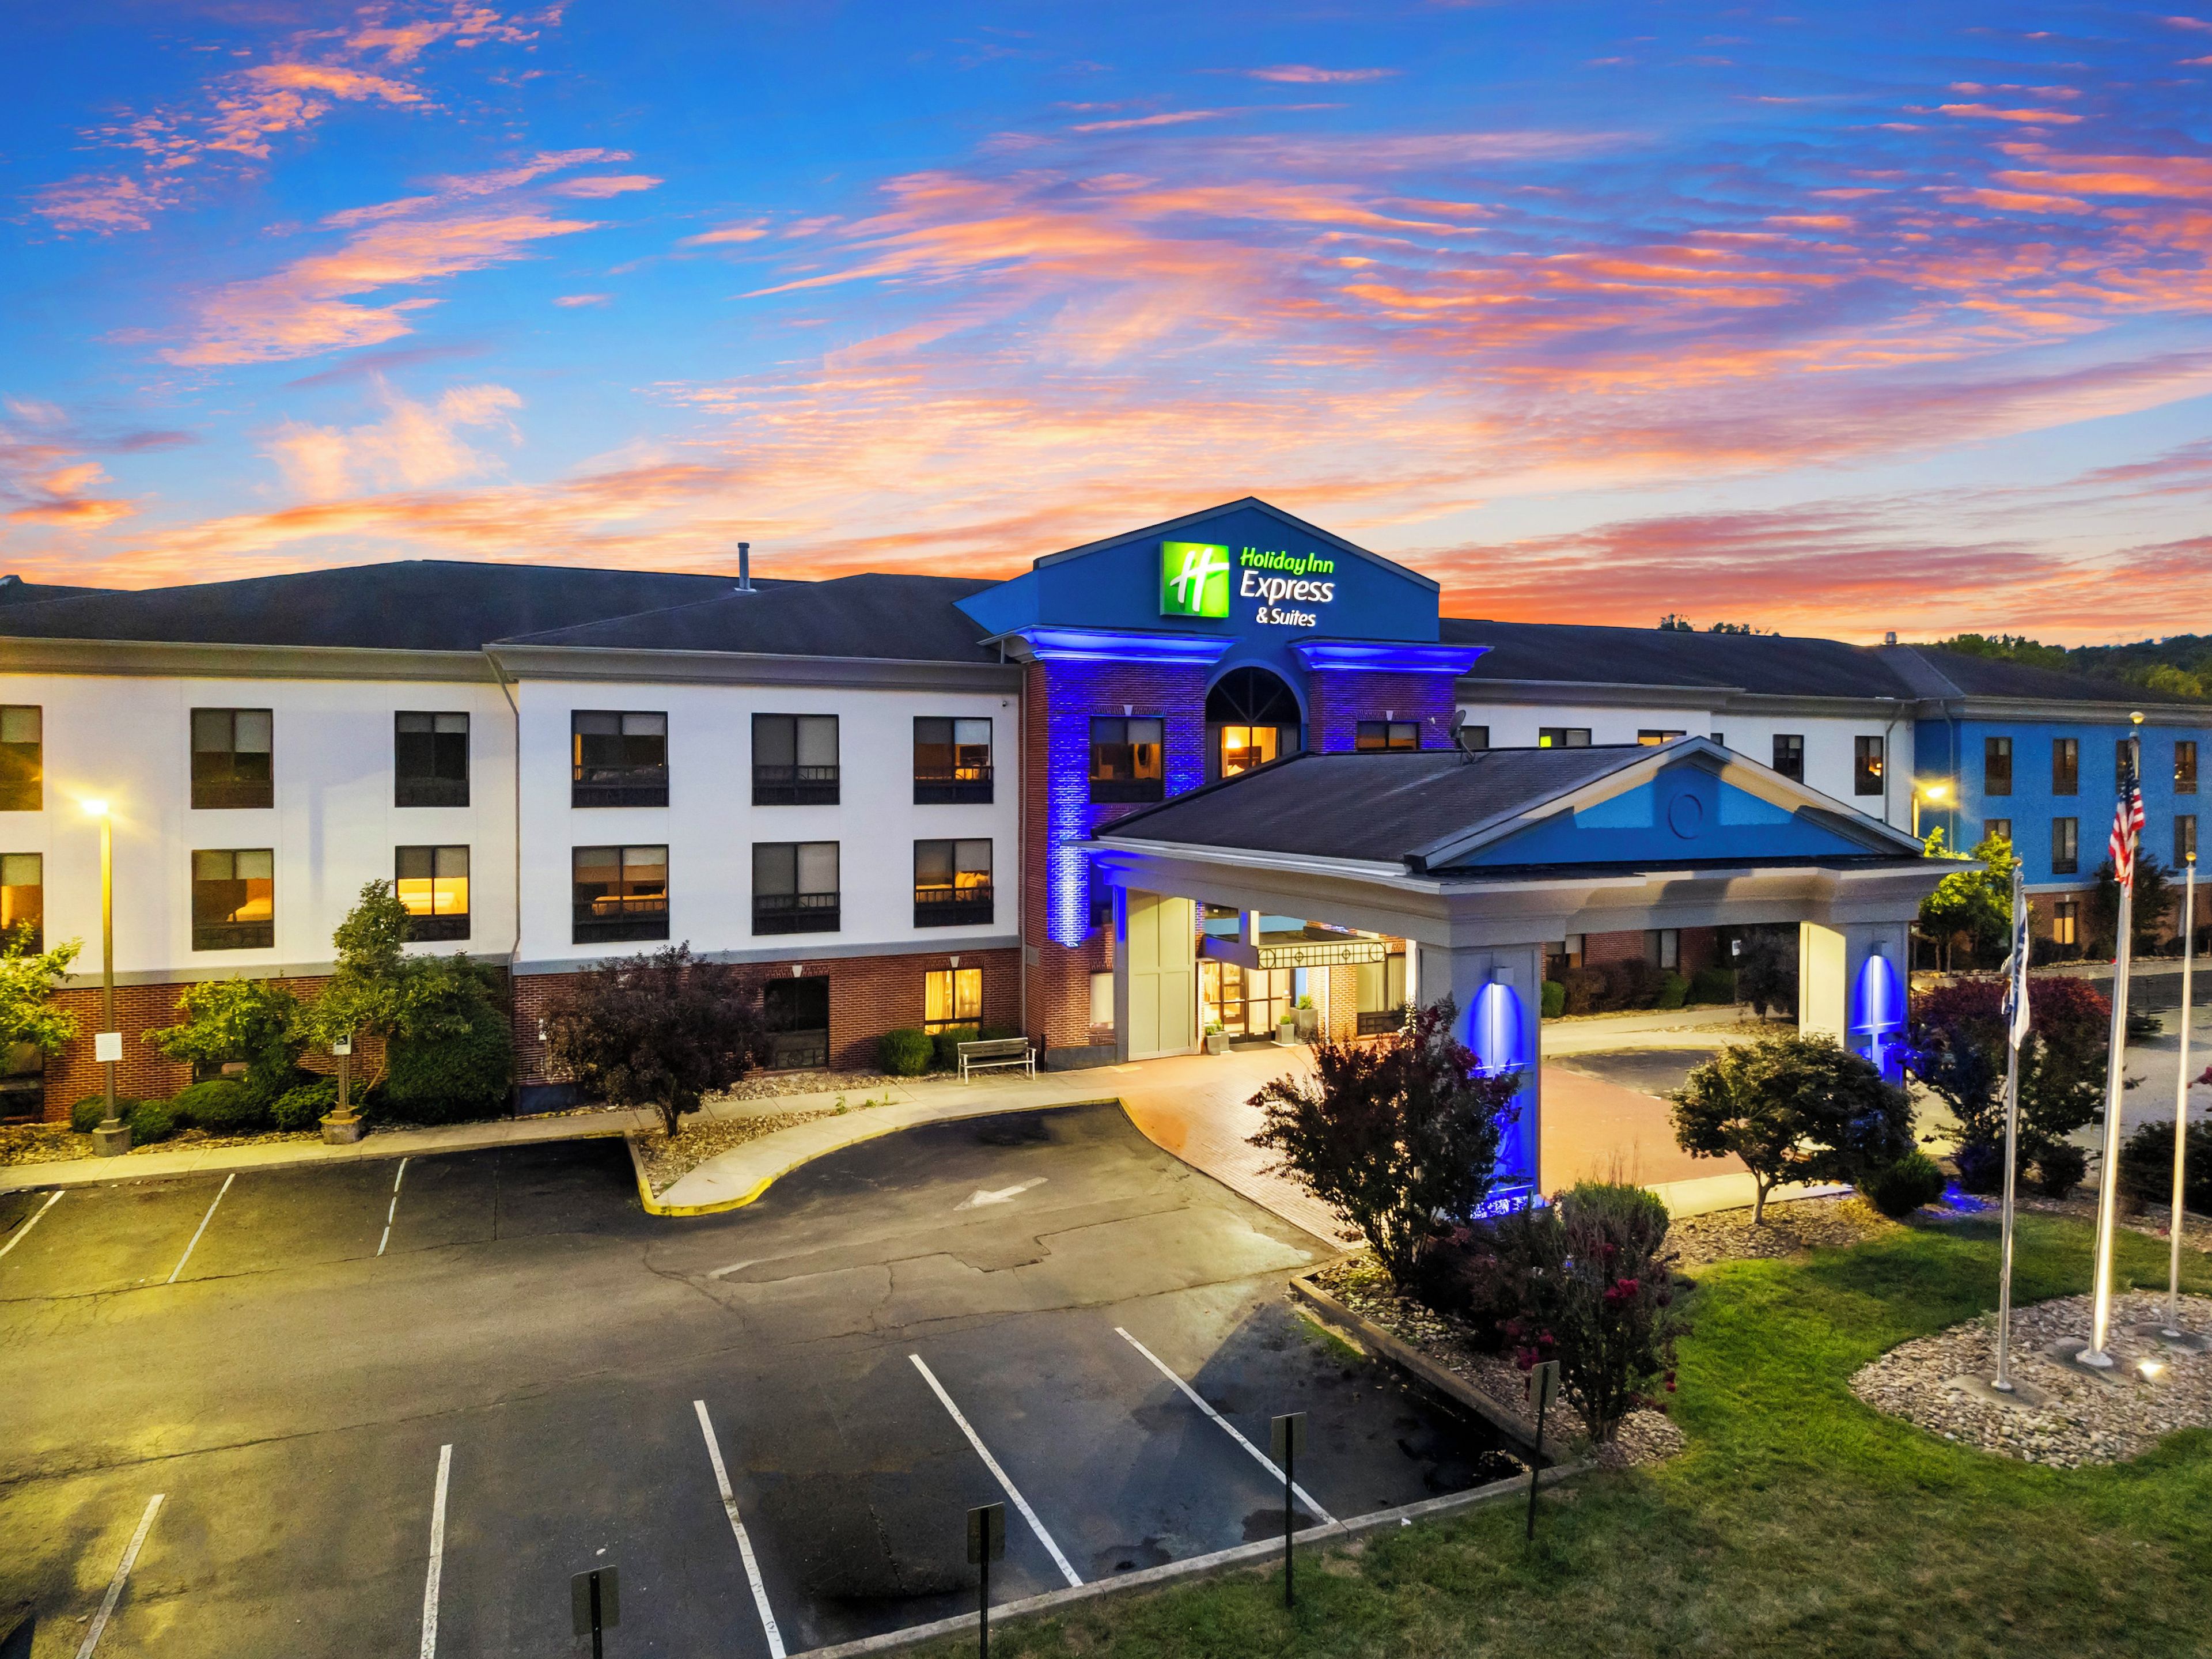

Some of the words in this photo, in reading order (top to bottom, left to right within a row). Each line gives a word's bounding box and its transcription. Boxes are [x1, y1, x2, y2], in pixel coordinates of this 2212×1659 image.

[1240, 546, 1306, 575] Holiday
[1306, 552, 1335, 574] Inn
[1240, 570, 1335, 606] Express
[1256, 607, 1268, 624] &
[1270, 608, 1316, 627] Suites
